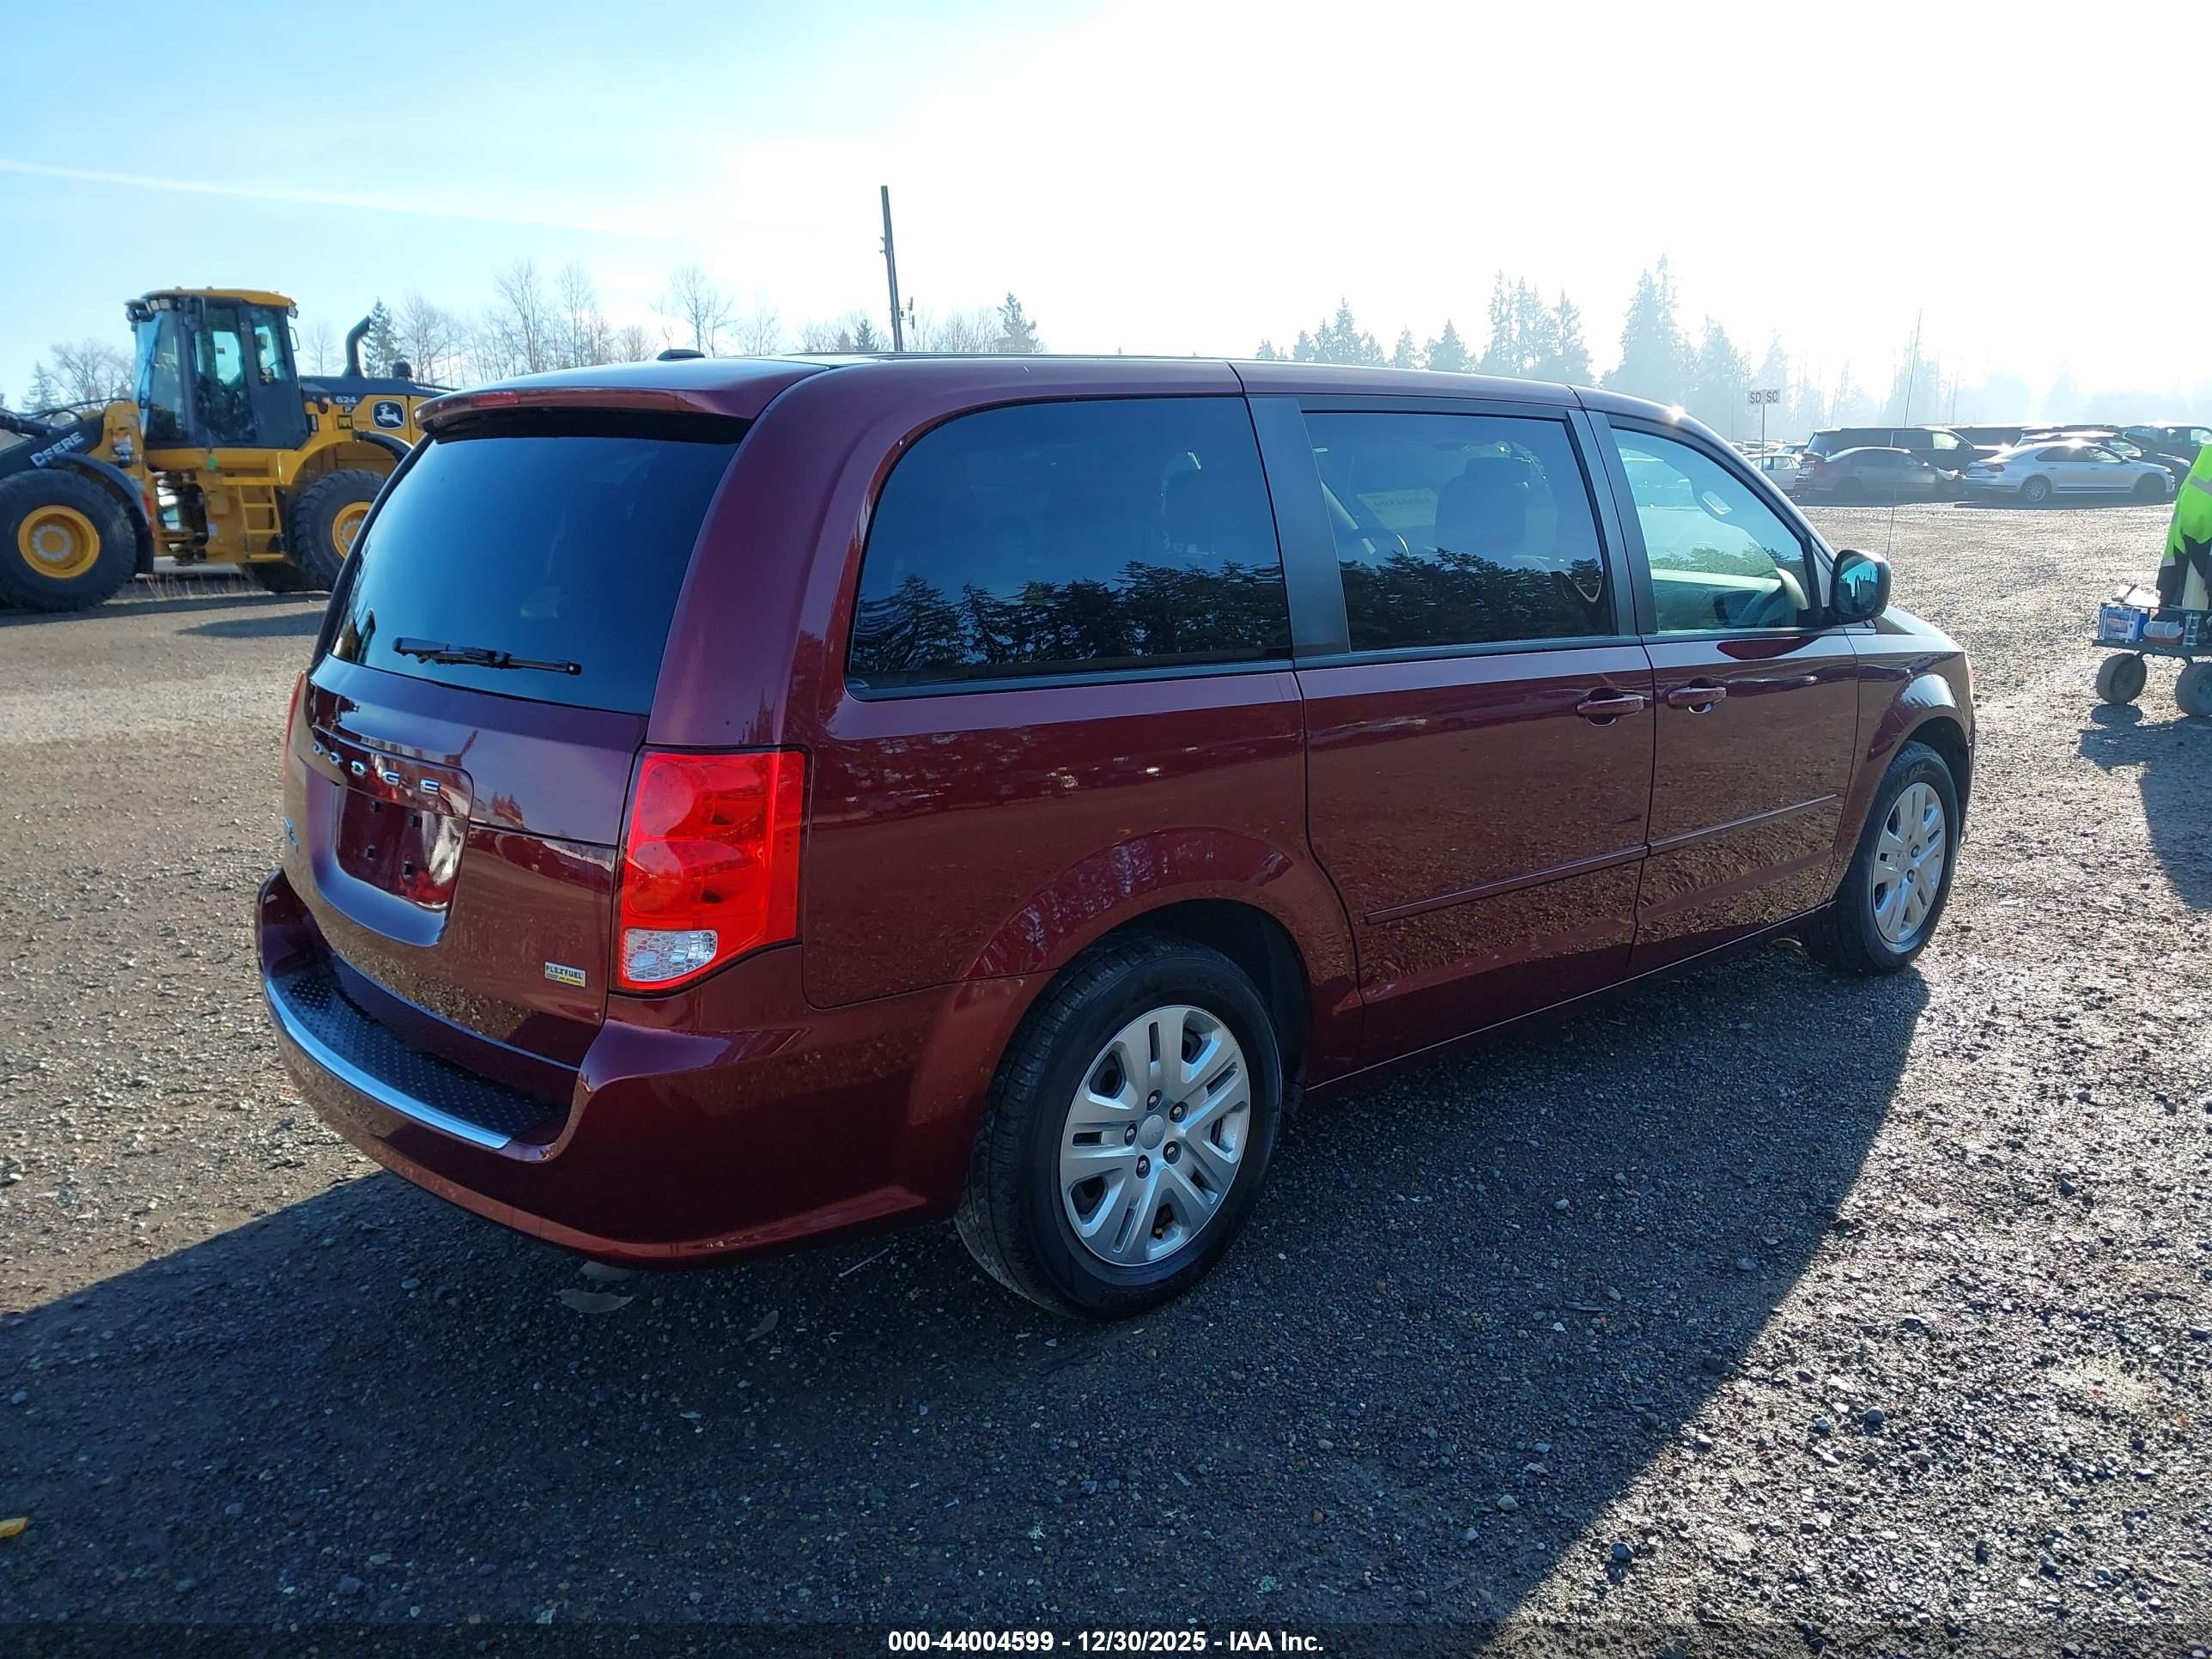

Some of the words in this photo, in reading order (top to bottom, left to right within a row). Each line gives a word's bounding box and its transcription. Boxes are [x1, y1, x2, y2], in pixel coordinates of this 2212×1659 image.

[1750, 392, 1761, 404] SD
[1766, 390, 1778, 403] SC
[29, 431, 84, 468] DEERE
[313, 741, 441, 796] DODGE
[546, 965, 582, 980] FLEXFUEL
